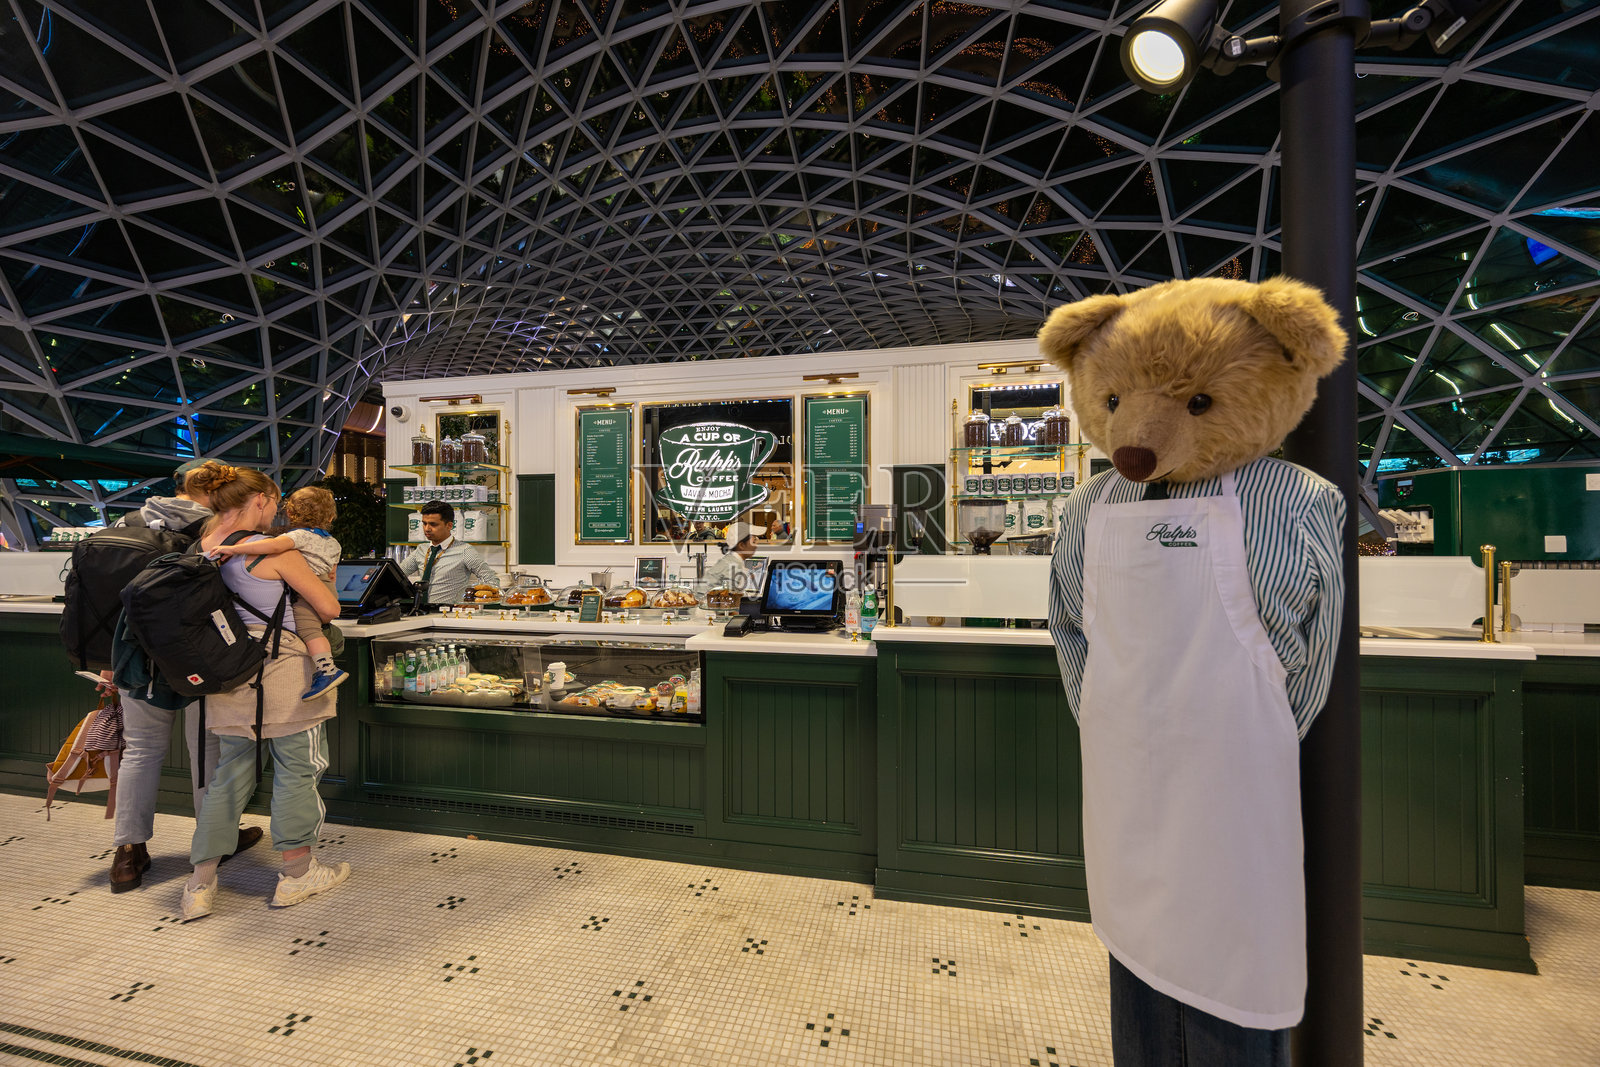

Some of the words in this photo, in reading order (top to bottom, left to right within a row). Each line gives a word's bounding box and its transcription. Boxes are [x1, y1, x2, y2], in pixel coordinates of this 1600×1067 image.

[680, 433, 690, 443] A
[694, 432, 720, 442] CUP
[723, 433, 741, 443] OF
[669, 448, 742, 487] Ralph's
[708, 488, 732, 499] MOCHA
[1146, 523, 1197, 541] Ralph's
